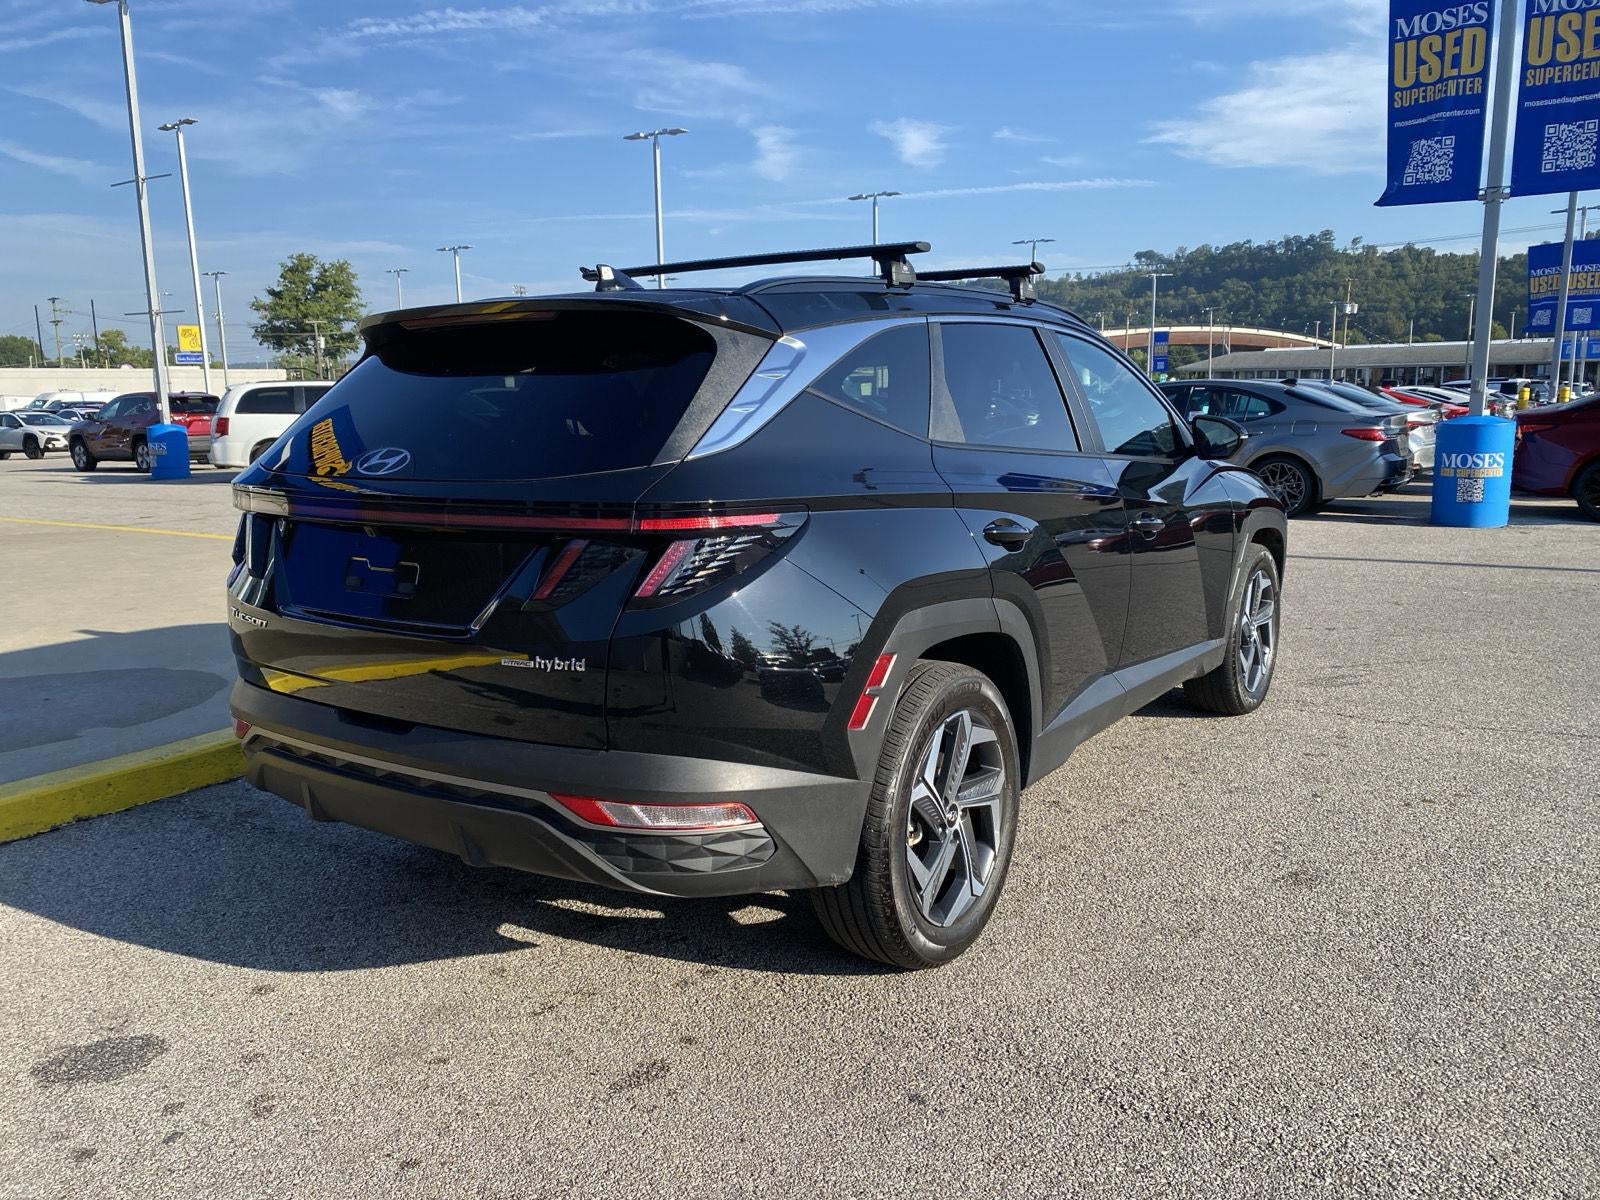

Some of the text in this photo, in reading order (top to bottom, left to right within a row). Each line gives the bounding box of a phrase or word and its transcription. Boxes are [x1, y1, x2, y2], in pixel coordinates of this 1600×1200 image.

[1394, 1, 1489, 39] MOSES
[1528, 9, 1600, 66] USE
[1393, 27, 1487, 88] USED
[1525, 60, 1600, 87] SUPERCEN
[1393, 77, 1483, 109] SUPERCENTER
[1441, 452, 1505, 469] MOSES
[535, 655, 586, 672] hybrid
